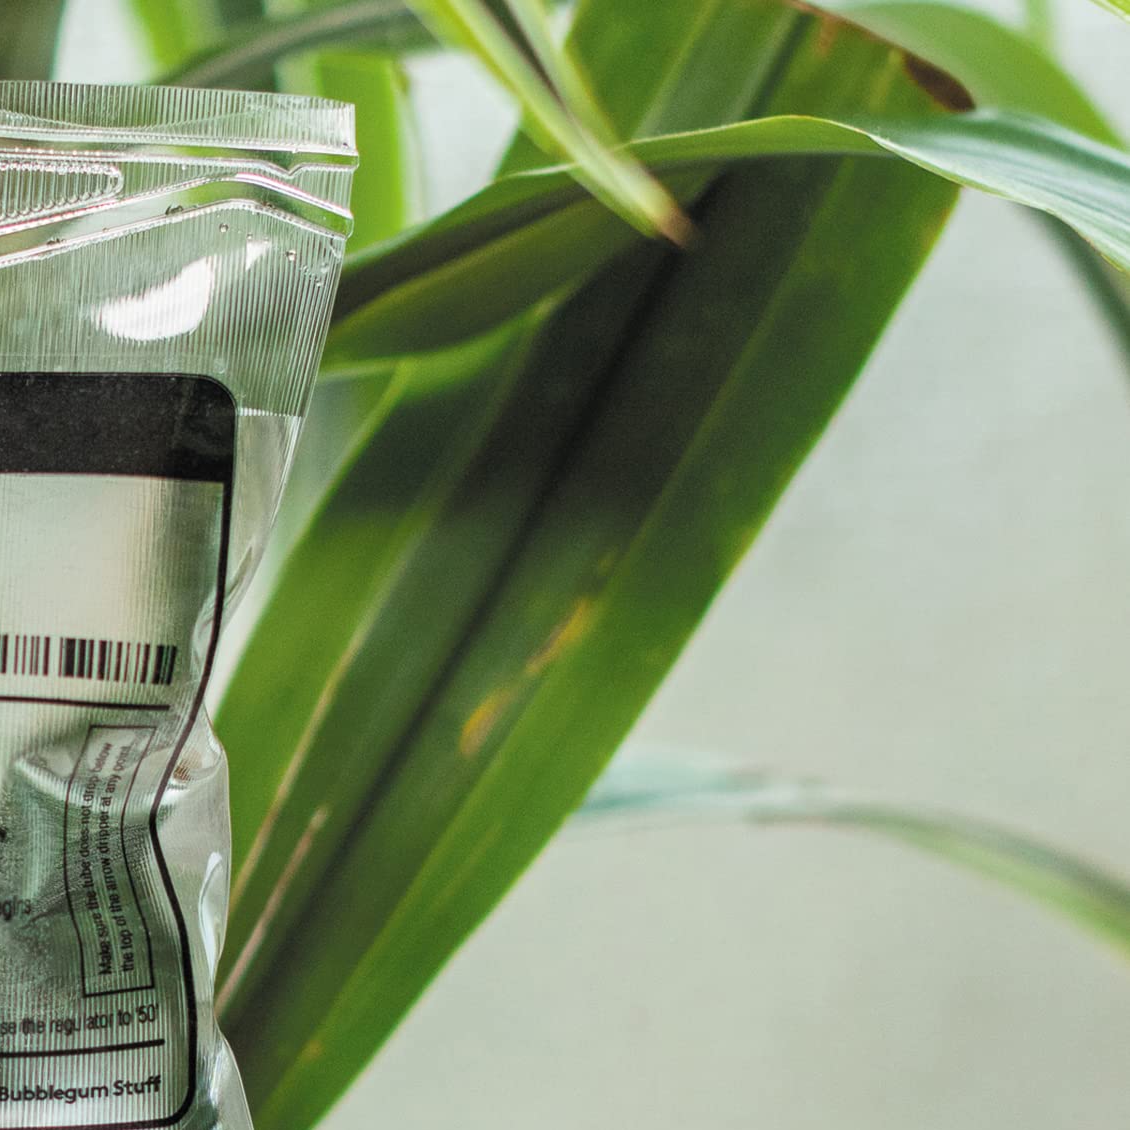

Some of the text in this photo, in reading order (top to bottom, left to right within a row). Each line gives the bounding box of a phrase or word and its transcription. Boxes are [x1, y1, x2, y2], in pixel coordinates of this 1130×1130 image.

[105, 774, 121, 793] any
[100, 796, 111, 806] at
[97, 811, 110, 853] dripper
[80, 743, 113, 975] Make sure the tube does not drop below
[102, 858, 118, 890] arrow
[108, 894, 122, 912] the
[112, 915, 127, 926] of
[118, 929, 133, 949] top
[118, 952, 134, 972] the
[22, 1016, 44, 1036] the
[118, 1009, 130, 1027] to
[113, 1075, 162, 1097] Stuff
